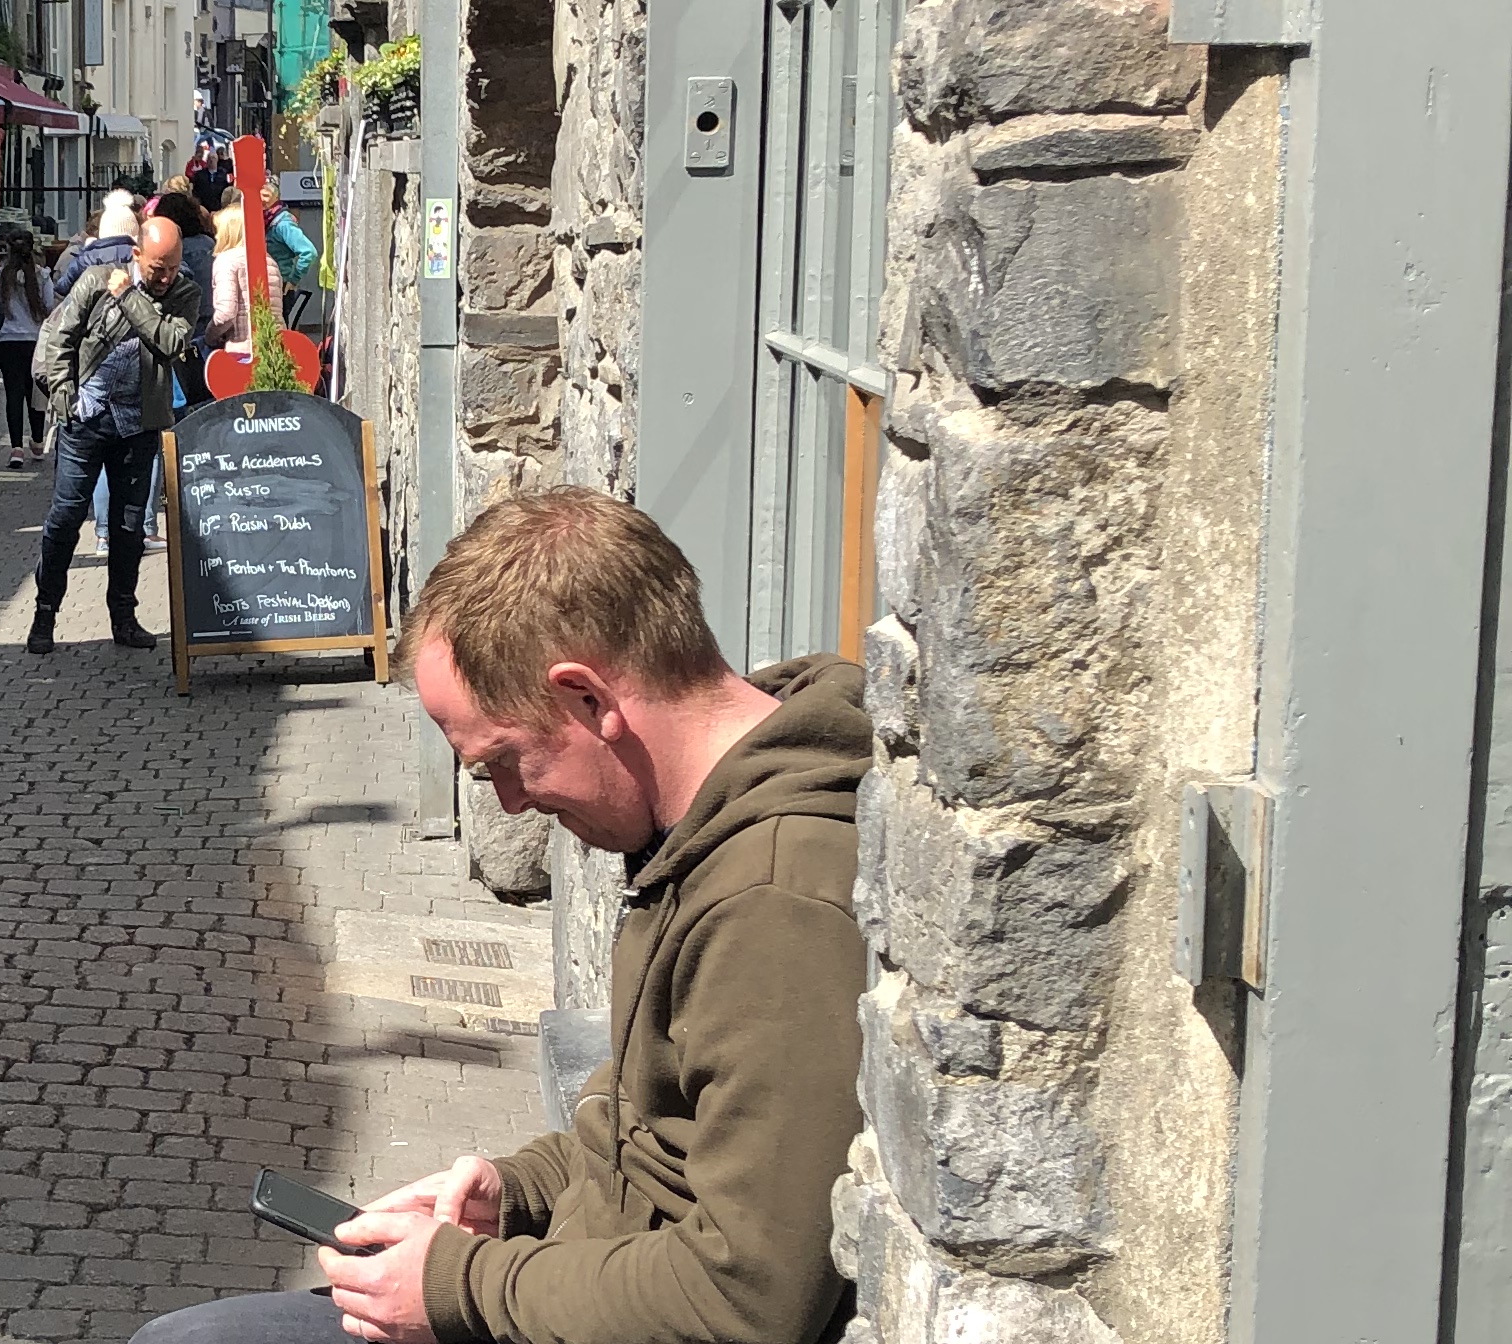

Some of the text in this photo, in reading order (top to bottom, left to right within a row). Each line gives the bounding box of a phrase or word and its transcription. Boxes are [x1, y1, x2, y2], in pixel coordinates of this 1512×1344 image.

[233, 416, 302, 434] GUINNESS
[214, 453, 238, 471] The
[240, 617, 259, 626] taste
[260, 612, 273, 627] of
[274, 612, 301, 625] IRISH
[304, 611, 336, 624] BEERS
